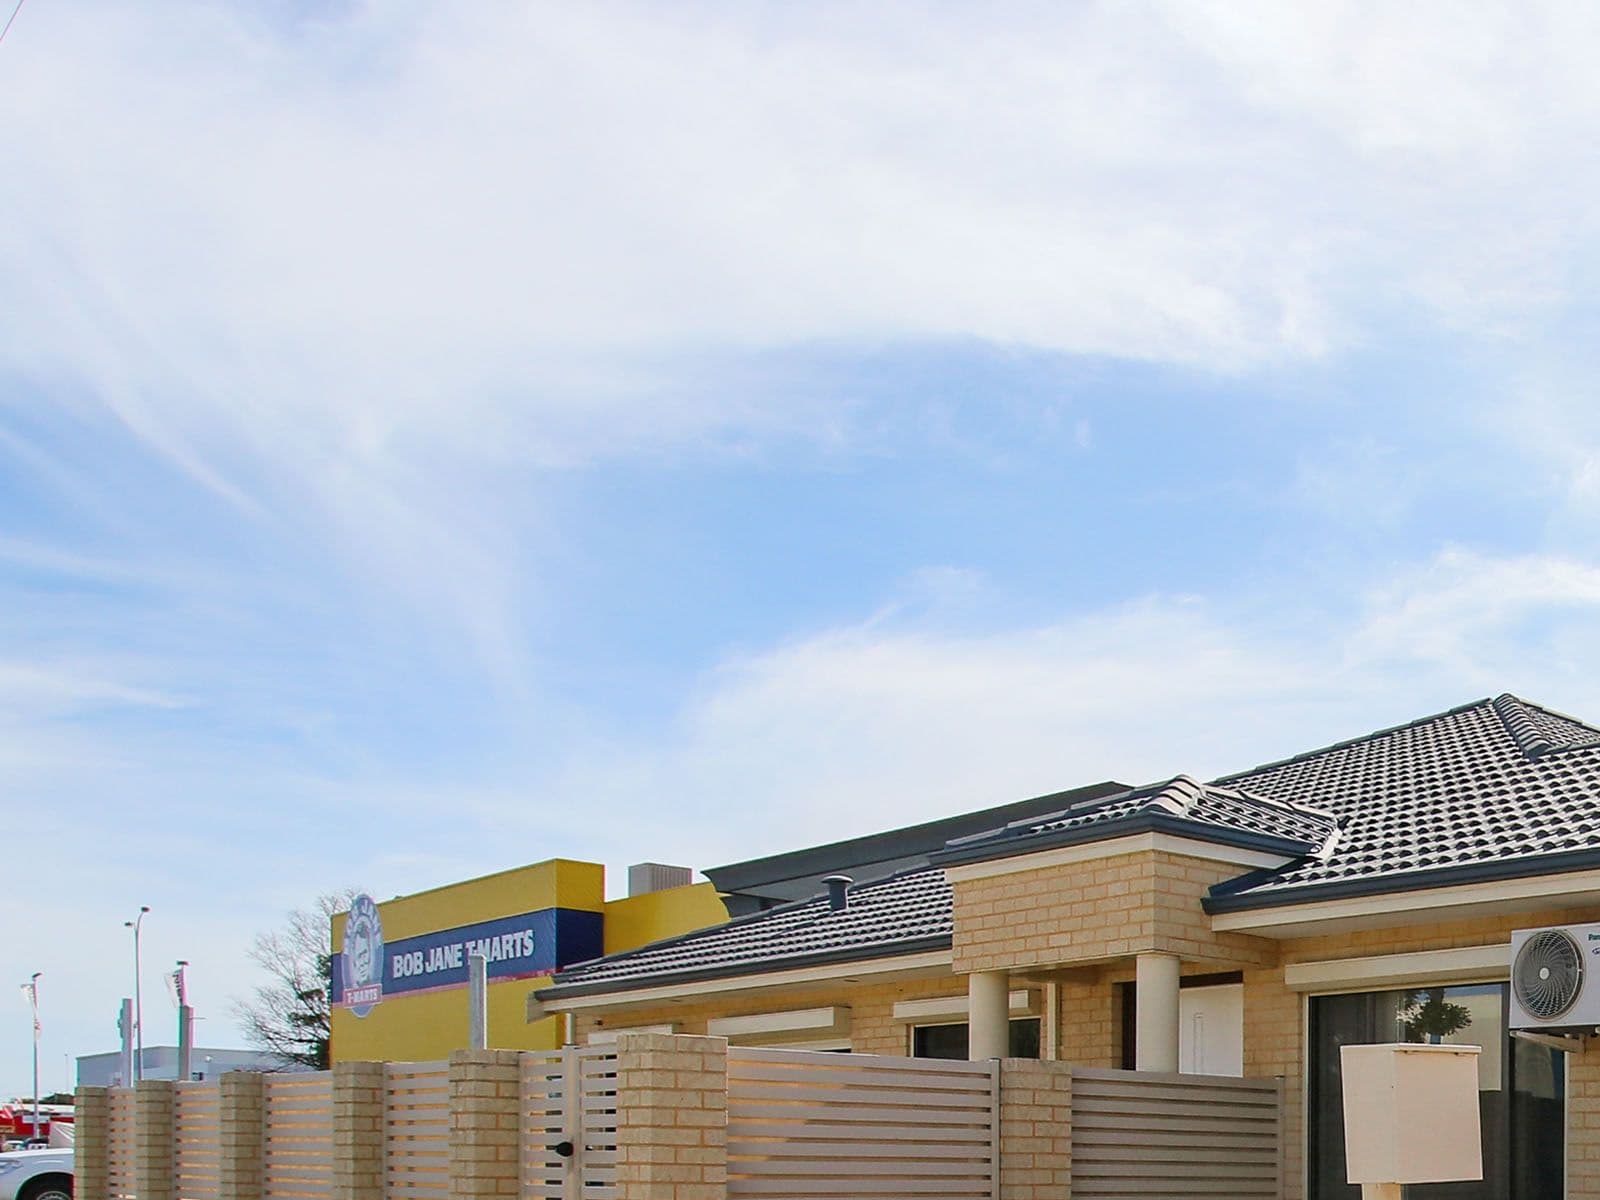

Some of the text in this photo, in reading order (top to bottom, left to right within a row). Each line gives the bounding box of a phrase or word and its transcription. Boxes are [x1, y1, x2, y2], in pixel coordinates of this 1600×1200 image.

[393, 929, 534, 978] BOB JANE T-MARTS
[347, 989, 378, 1004] T-MARTS
